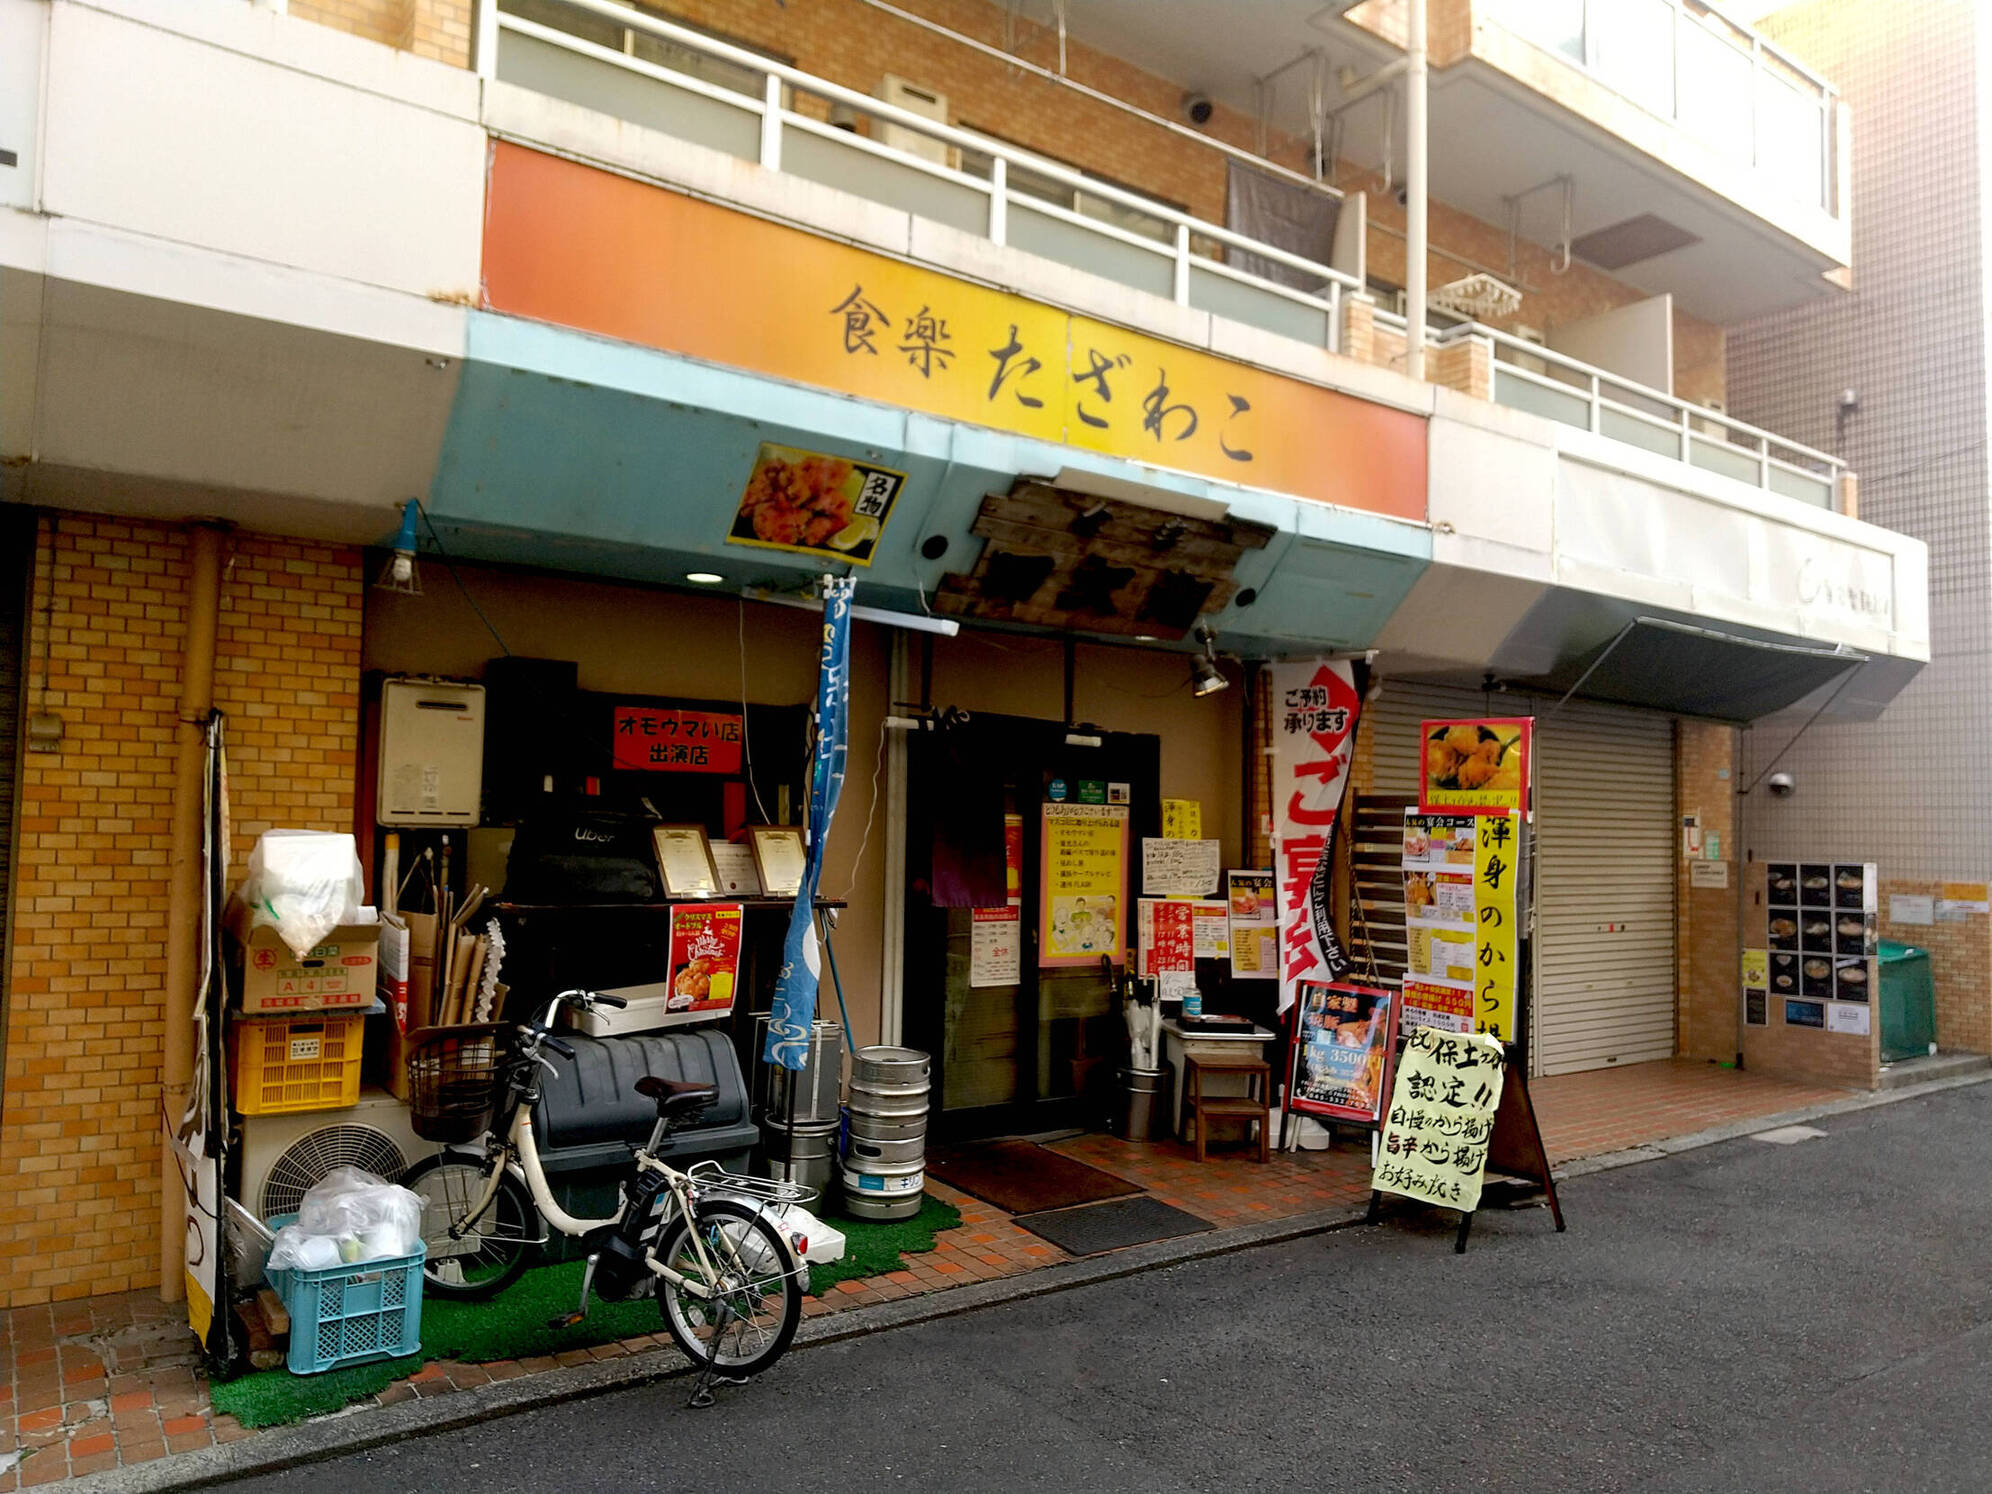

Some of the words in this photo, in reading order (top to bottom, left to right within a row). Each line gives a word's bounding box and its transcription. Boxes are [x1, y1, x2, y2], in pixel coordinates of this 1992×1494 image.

[831, 285, 956, 379] 食楽
[988, 325, 1254, 462] たざわこ
[855, 472, 894, 518] 名物
[1285, 686, 1328, 708] ご予約
[618, 714, 742, 743] オモウマい店
[1283, 708, 1349, 735] 承ります
[648, 743, 710, 767] 出演店
[575, 827, 616, 843] Uber
[1175, 905, 1192, 972] 営業時間
[1390, 1105, 1494, 1146] 自慢のから揚げ
[1386, 1132, 1487, 1175] 旨辛から揚げ
